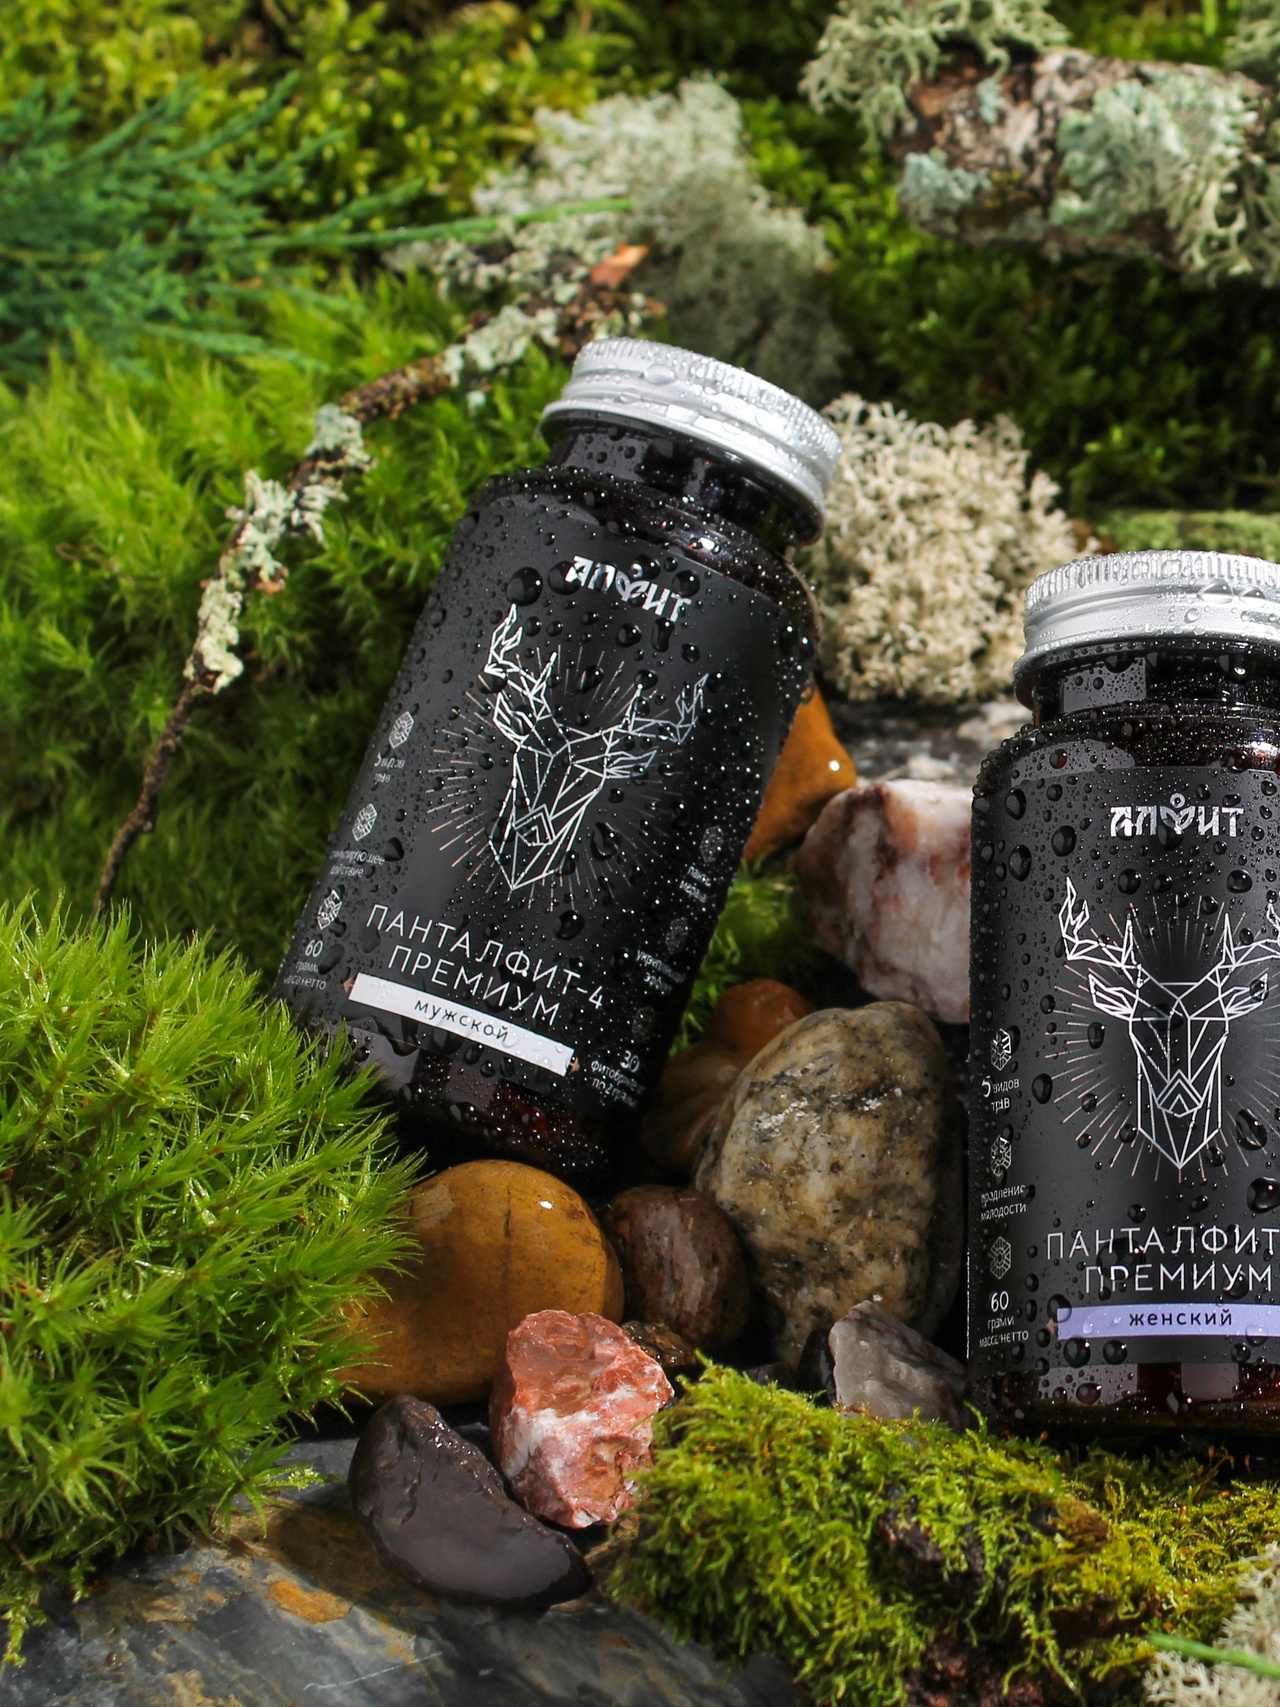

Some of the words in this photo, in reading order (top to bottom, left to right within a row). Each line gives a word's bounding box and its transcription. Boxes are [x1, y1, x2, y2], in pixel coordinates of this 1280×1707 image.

[305, 940, 323, 957] 60
[366, 904, 603, 1009] ПАНТАЛФИТ-4
[388, 945, 560, 1026] ПРЕМИУМ
[414, 999, 510, 1042] мужской
[620, 1050, 640, 1073] 30
[1085, 1260, 1272, 1293] ПРЕМИУМ
[991, 1290, 1009, 1312] 60
[1129, 1309, 1232, 1326] женский
